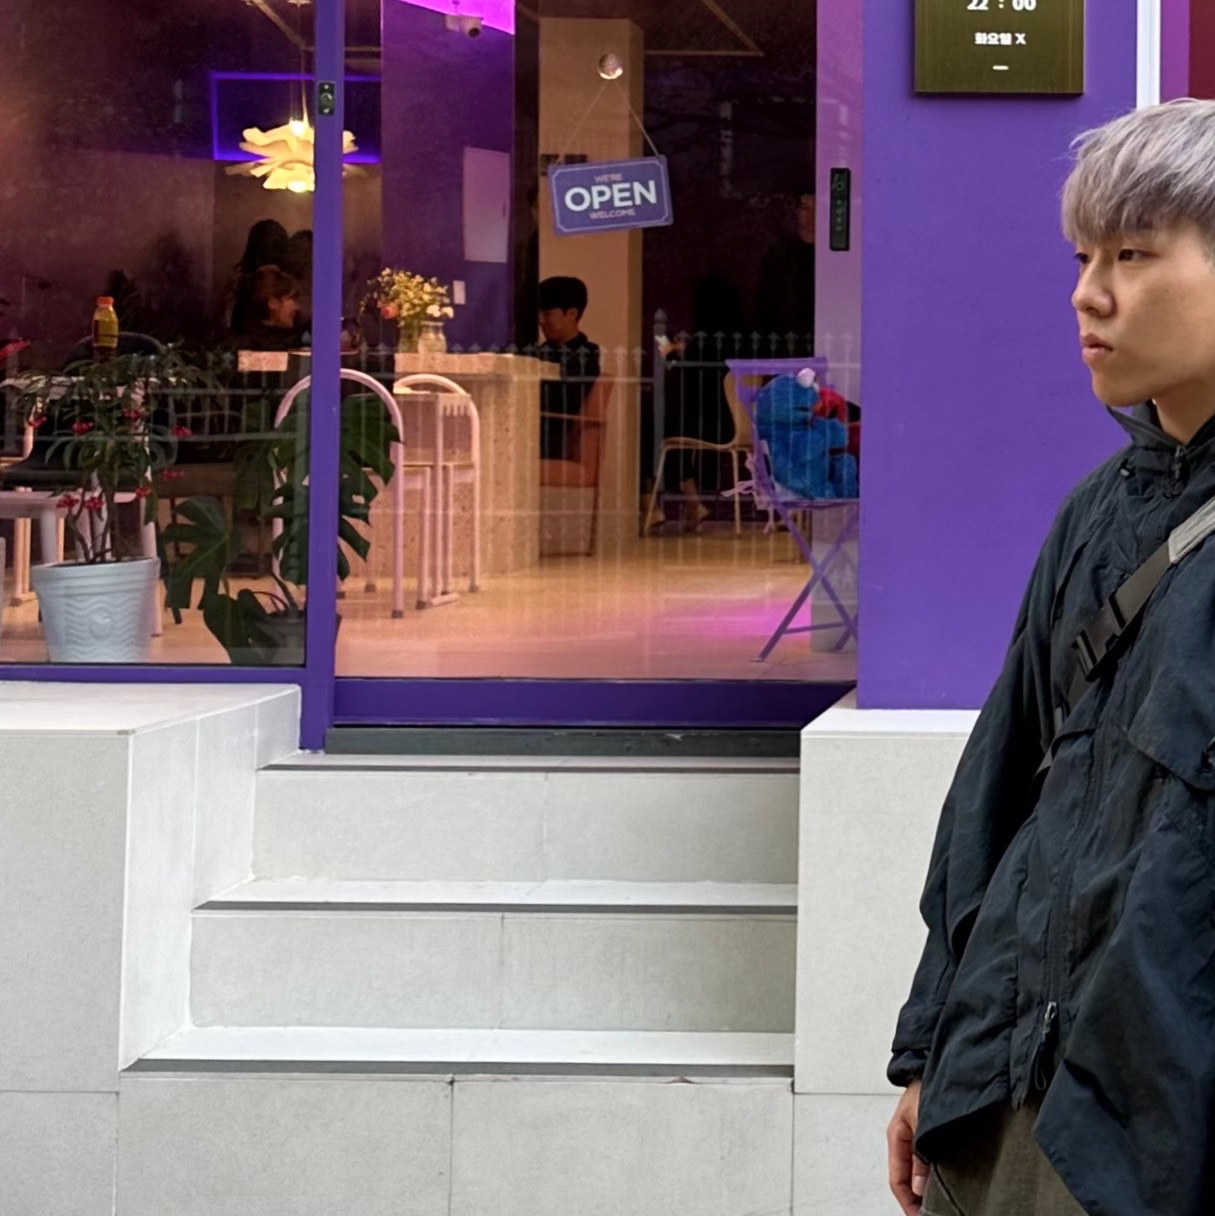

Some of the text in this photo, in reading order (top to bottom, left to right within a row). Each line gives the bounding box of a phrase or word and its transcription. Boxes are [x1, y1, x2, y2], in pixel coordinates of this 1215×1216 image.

[974, 32, 1012, 45] 화요일
[564, 179, 658, 212] OPEN
[588, 207, 636, 220] WELCOME
